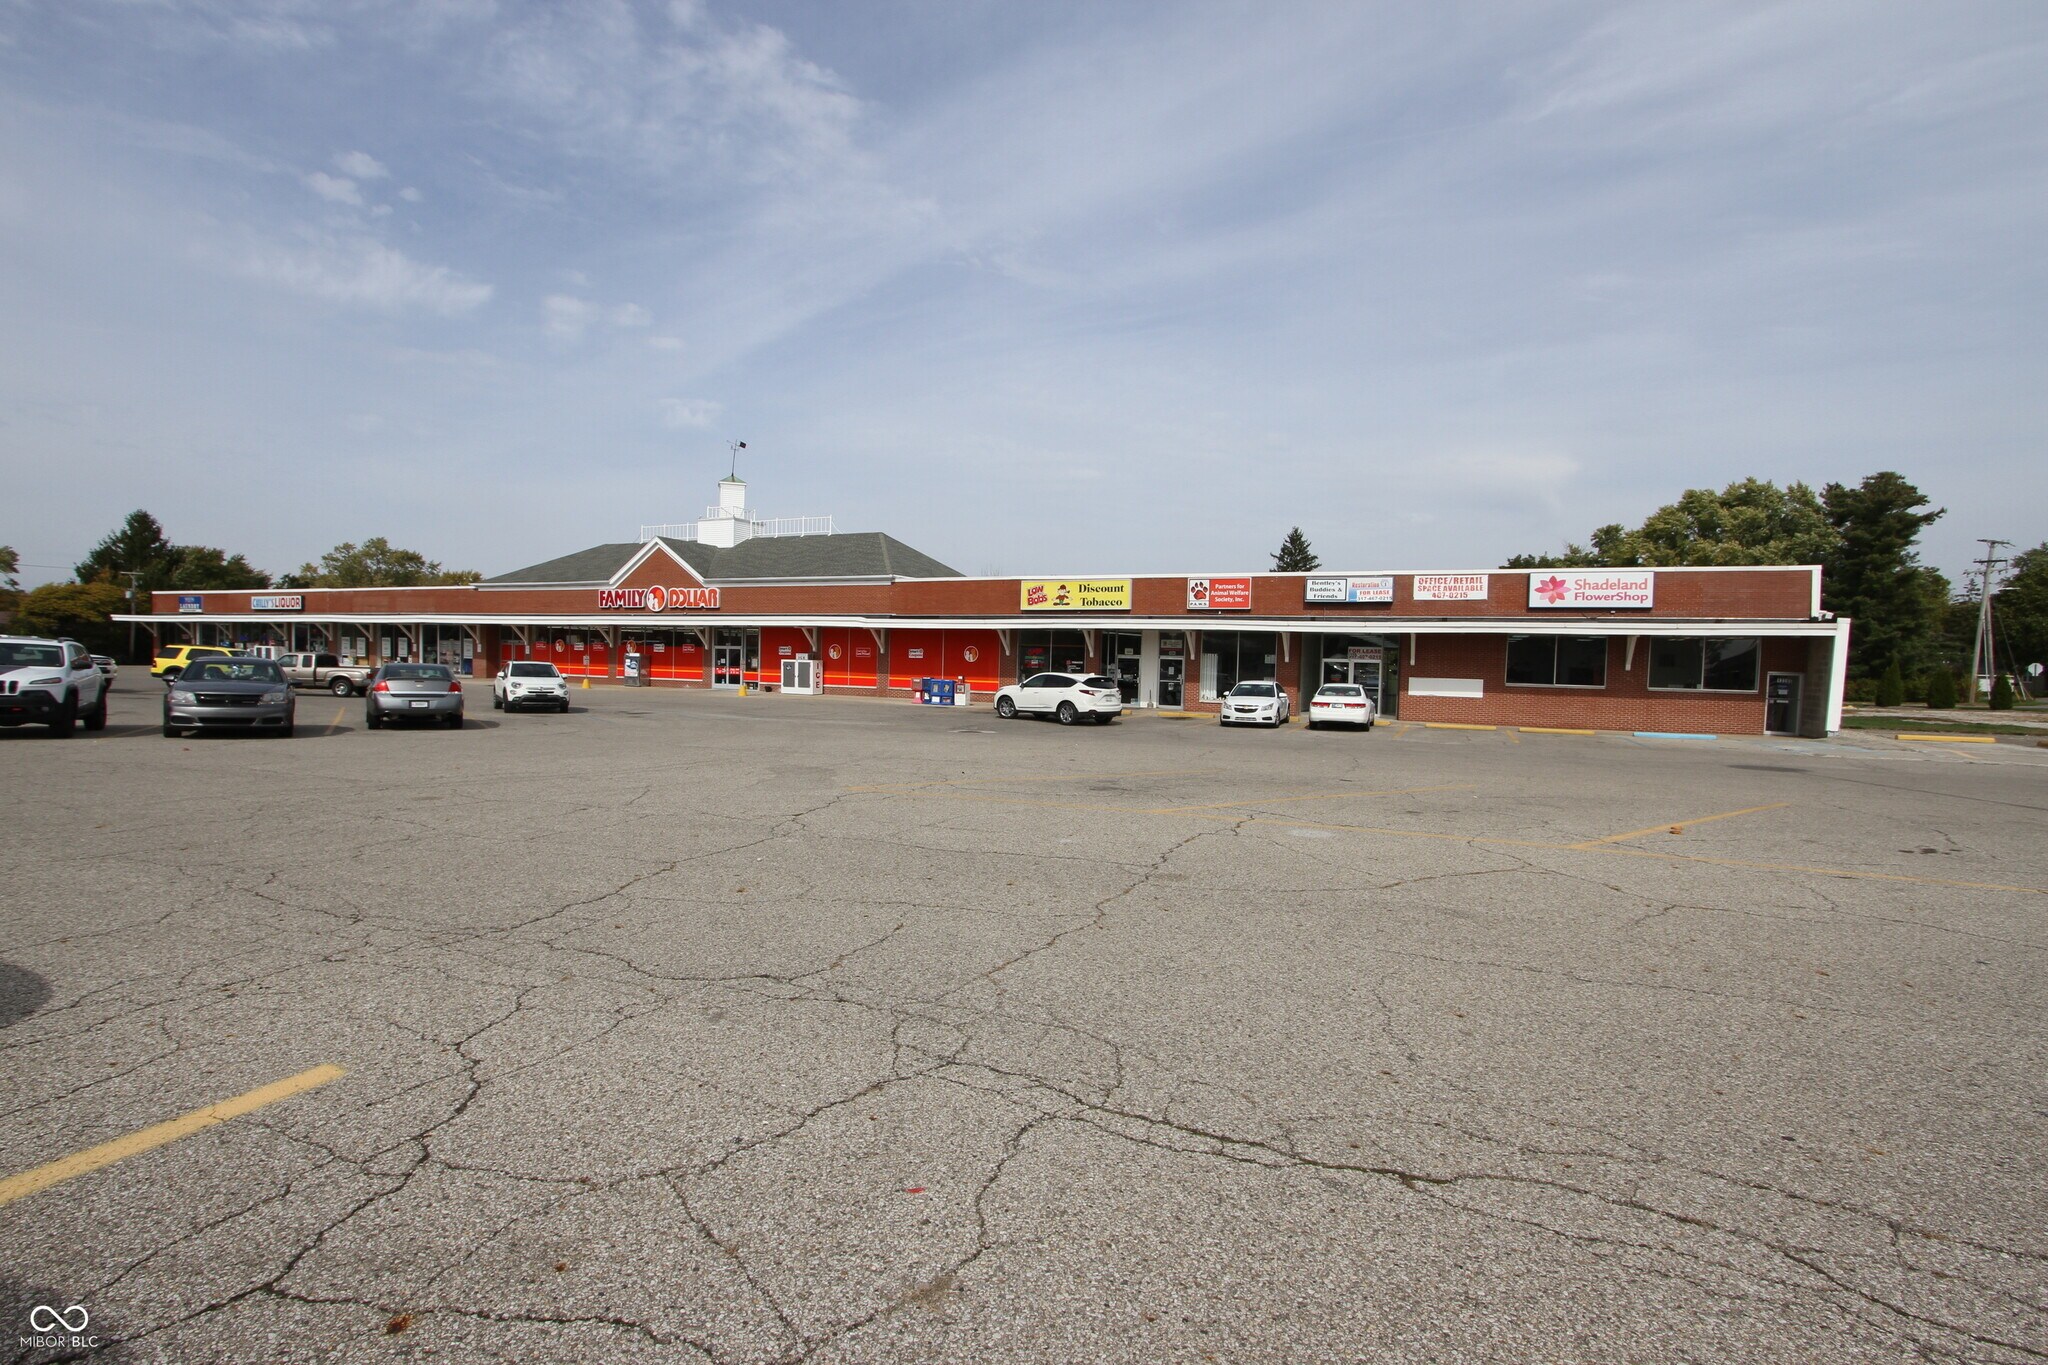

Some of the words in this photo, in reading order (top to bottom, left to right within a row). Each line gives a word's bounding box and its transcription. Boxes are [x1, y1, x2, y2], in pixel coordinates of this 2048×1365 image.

[1418, 577, 1483, 585] OFFICE/RETAIL
[1574, 578, 1648, 590] Shadeland
[1027, 585, 1044, 597] LOW
[1078, 583, 1124, 593] Discount
[274, 597, 300, 608] LIQUOR
[599, 589, 647, 608] FAMILY
[668, 587, 720, 608] DOLLAR
[1080, 597, 1123, 607] Tobacco
[1574, 592, 1648, 603] FlowerShop
